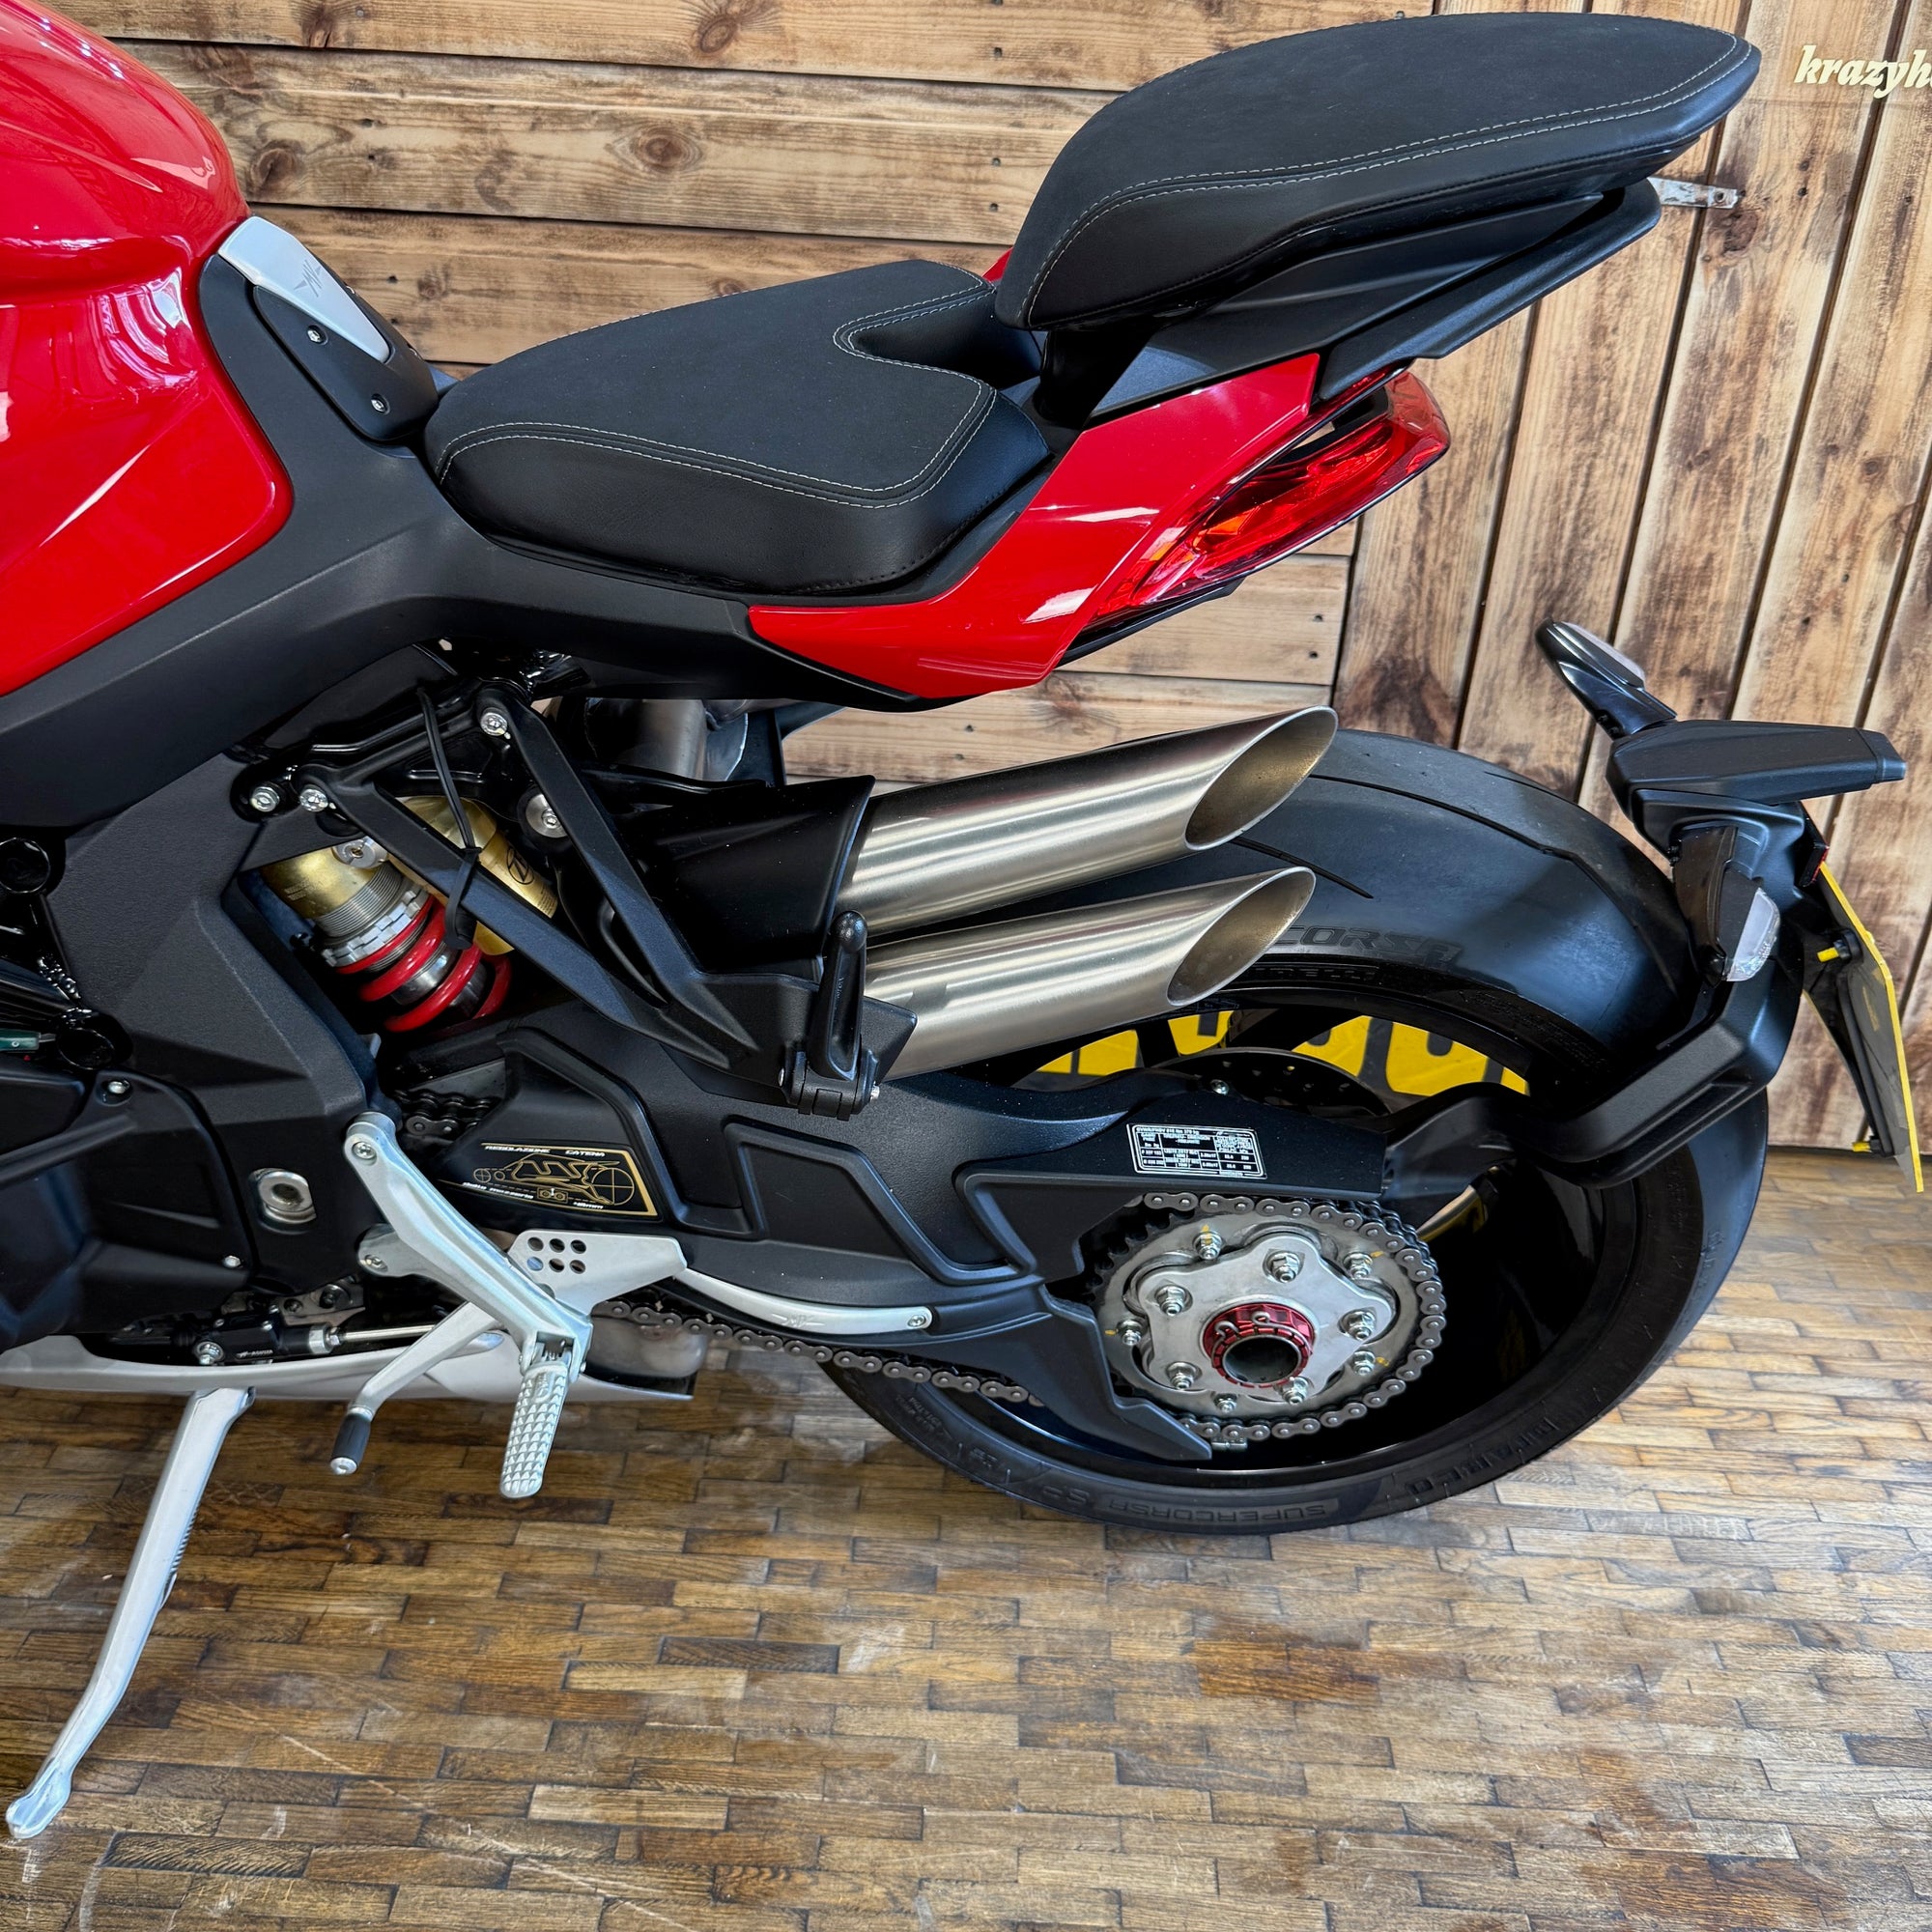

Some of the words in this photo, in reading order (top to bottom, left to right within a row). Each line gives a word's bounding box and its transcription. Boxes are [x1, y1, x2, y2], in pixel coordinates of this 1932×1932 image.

[1794, 44, 1932, 99] krazyh
[564, 1149, 606, 1158] CATENA
[1109, 1496, 1327, 1523] SUPERCORSA
